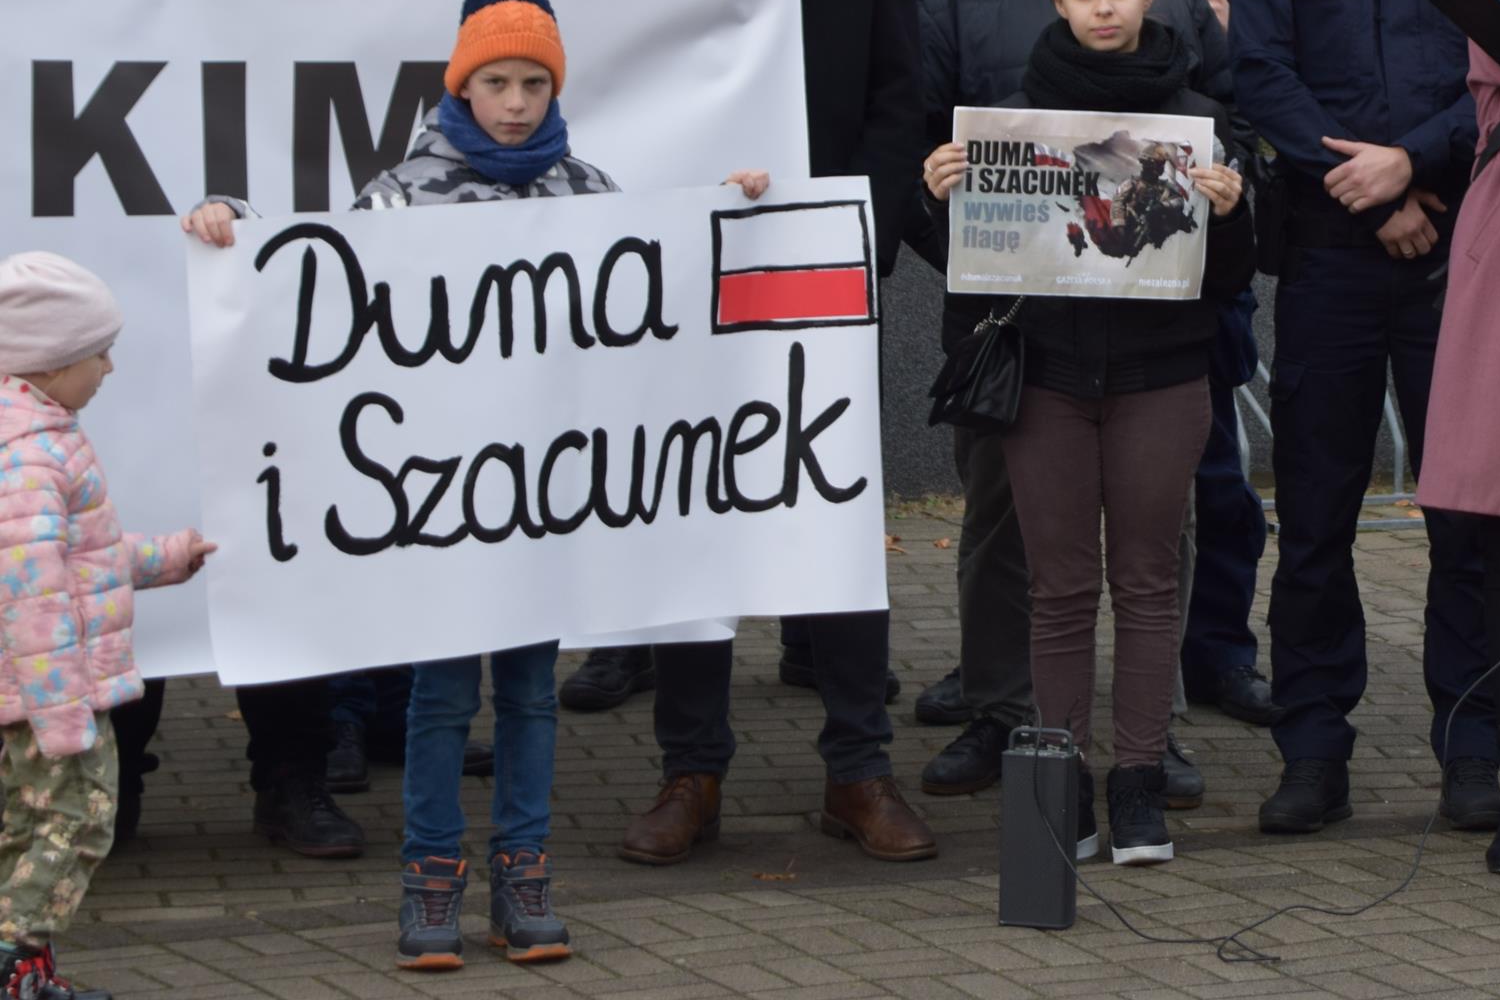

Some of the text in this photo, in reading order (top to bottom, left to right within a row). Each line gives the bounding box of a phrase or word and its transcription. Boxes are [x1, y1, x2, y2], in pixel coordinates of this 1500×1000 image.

[31, 60, 451, 217] KIM
[967, 140, 1036, 167] DUMA
[965, 168, 1100, 197] i SZACUNEK
[964, 197, 1050, 226] wywieś
[962, 226, 1020, 254] flagę
[256, 223, 679, 383] Duma
[257, 342, 867, 561] i Szacunek
